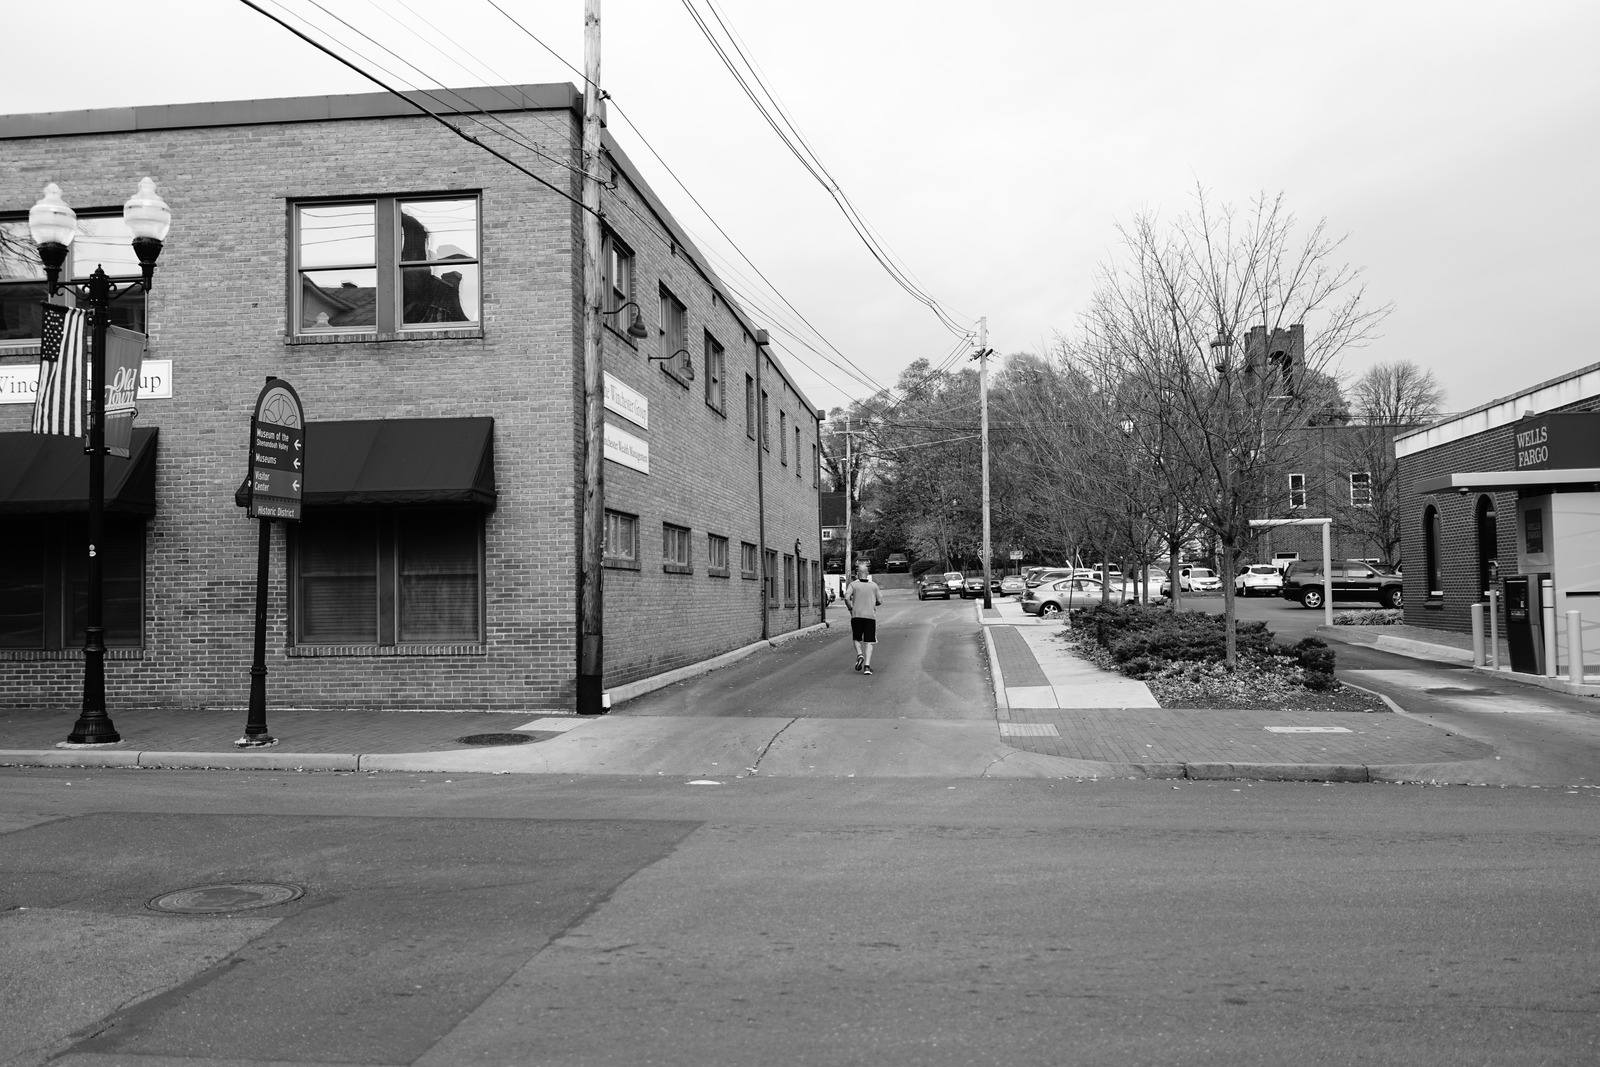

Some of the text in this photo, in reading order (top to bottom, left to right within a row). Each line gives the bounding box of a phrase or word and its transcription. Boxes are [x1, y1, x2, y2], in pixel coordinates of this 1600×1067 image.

[113, 366, 137, 392] Old
[104, 384, 135, 405] Town
[634, 399, 646, 423] Group
[256, 428, 289, 442] Museum of the
[1516, 426, 1548, 449] WELLS
[256, 438, 289, 452] Shenandoah Valley
[256, 453, 277, 464] Museums
[1518, 445, 1549, 467] FARGO
[255, 471, 270, 480] Visitor
[255, 481, 270, 491] Center
[258, 505, 295, 518] Historic District
